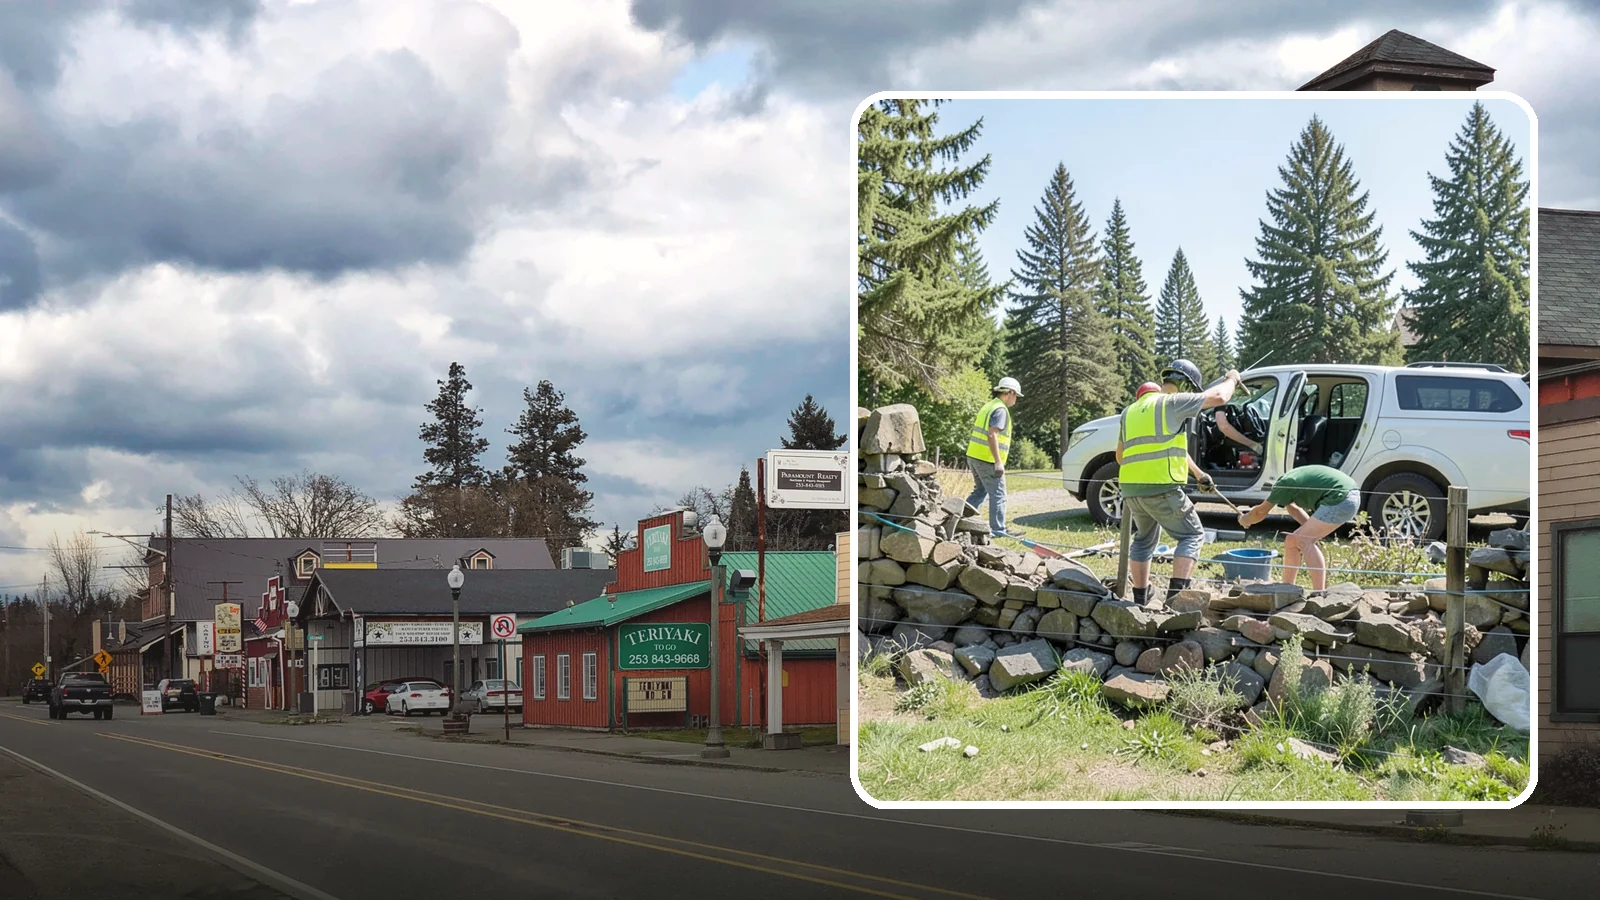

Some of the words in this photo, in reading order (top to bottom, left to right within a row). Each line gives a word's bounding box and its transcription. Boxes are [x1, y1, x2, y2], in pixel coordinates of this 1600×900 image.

[625, 627, 702, 646] TERIYAKI
[629, 655, 648, 664] 253
[652, 654, 700, 664] 843-9668
